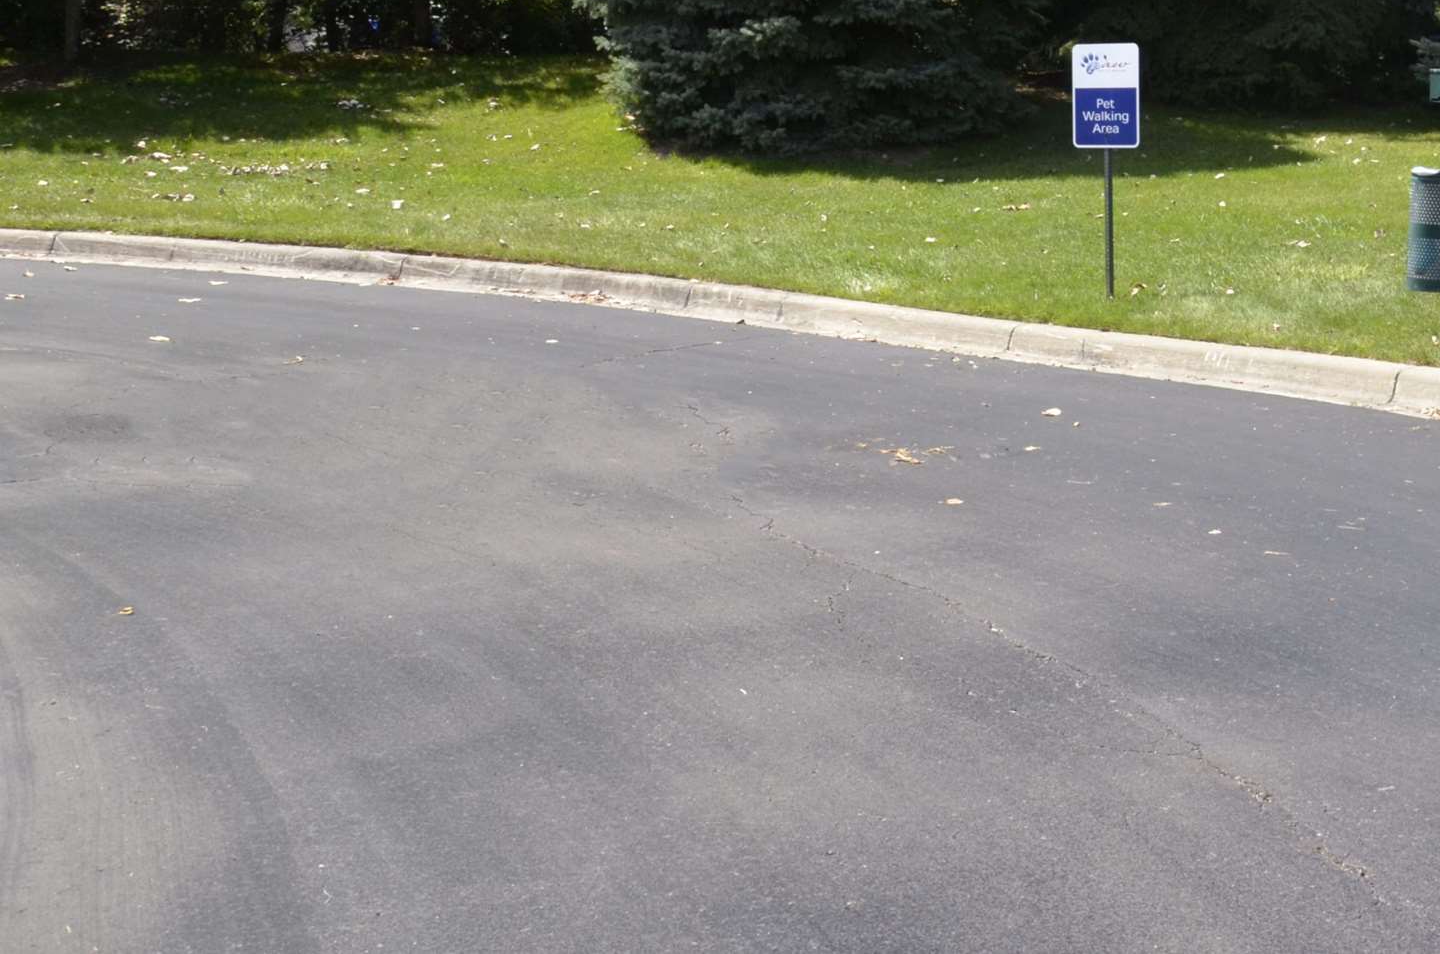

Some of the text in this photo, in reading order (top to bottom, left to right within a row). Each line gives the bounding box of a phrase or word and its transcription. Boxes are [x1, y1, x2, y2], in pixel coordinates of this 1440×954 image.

[1096, 98, 1115, 109] Pet
[1082, 110, 1129, 124] Walking
[1092, 123, 1120, 134] Area
